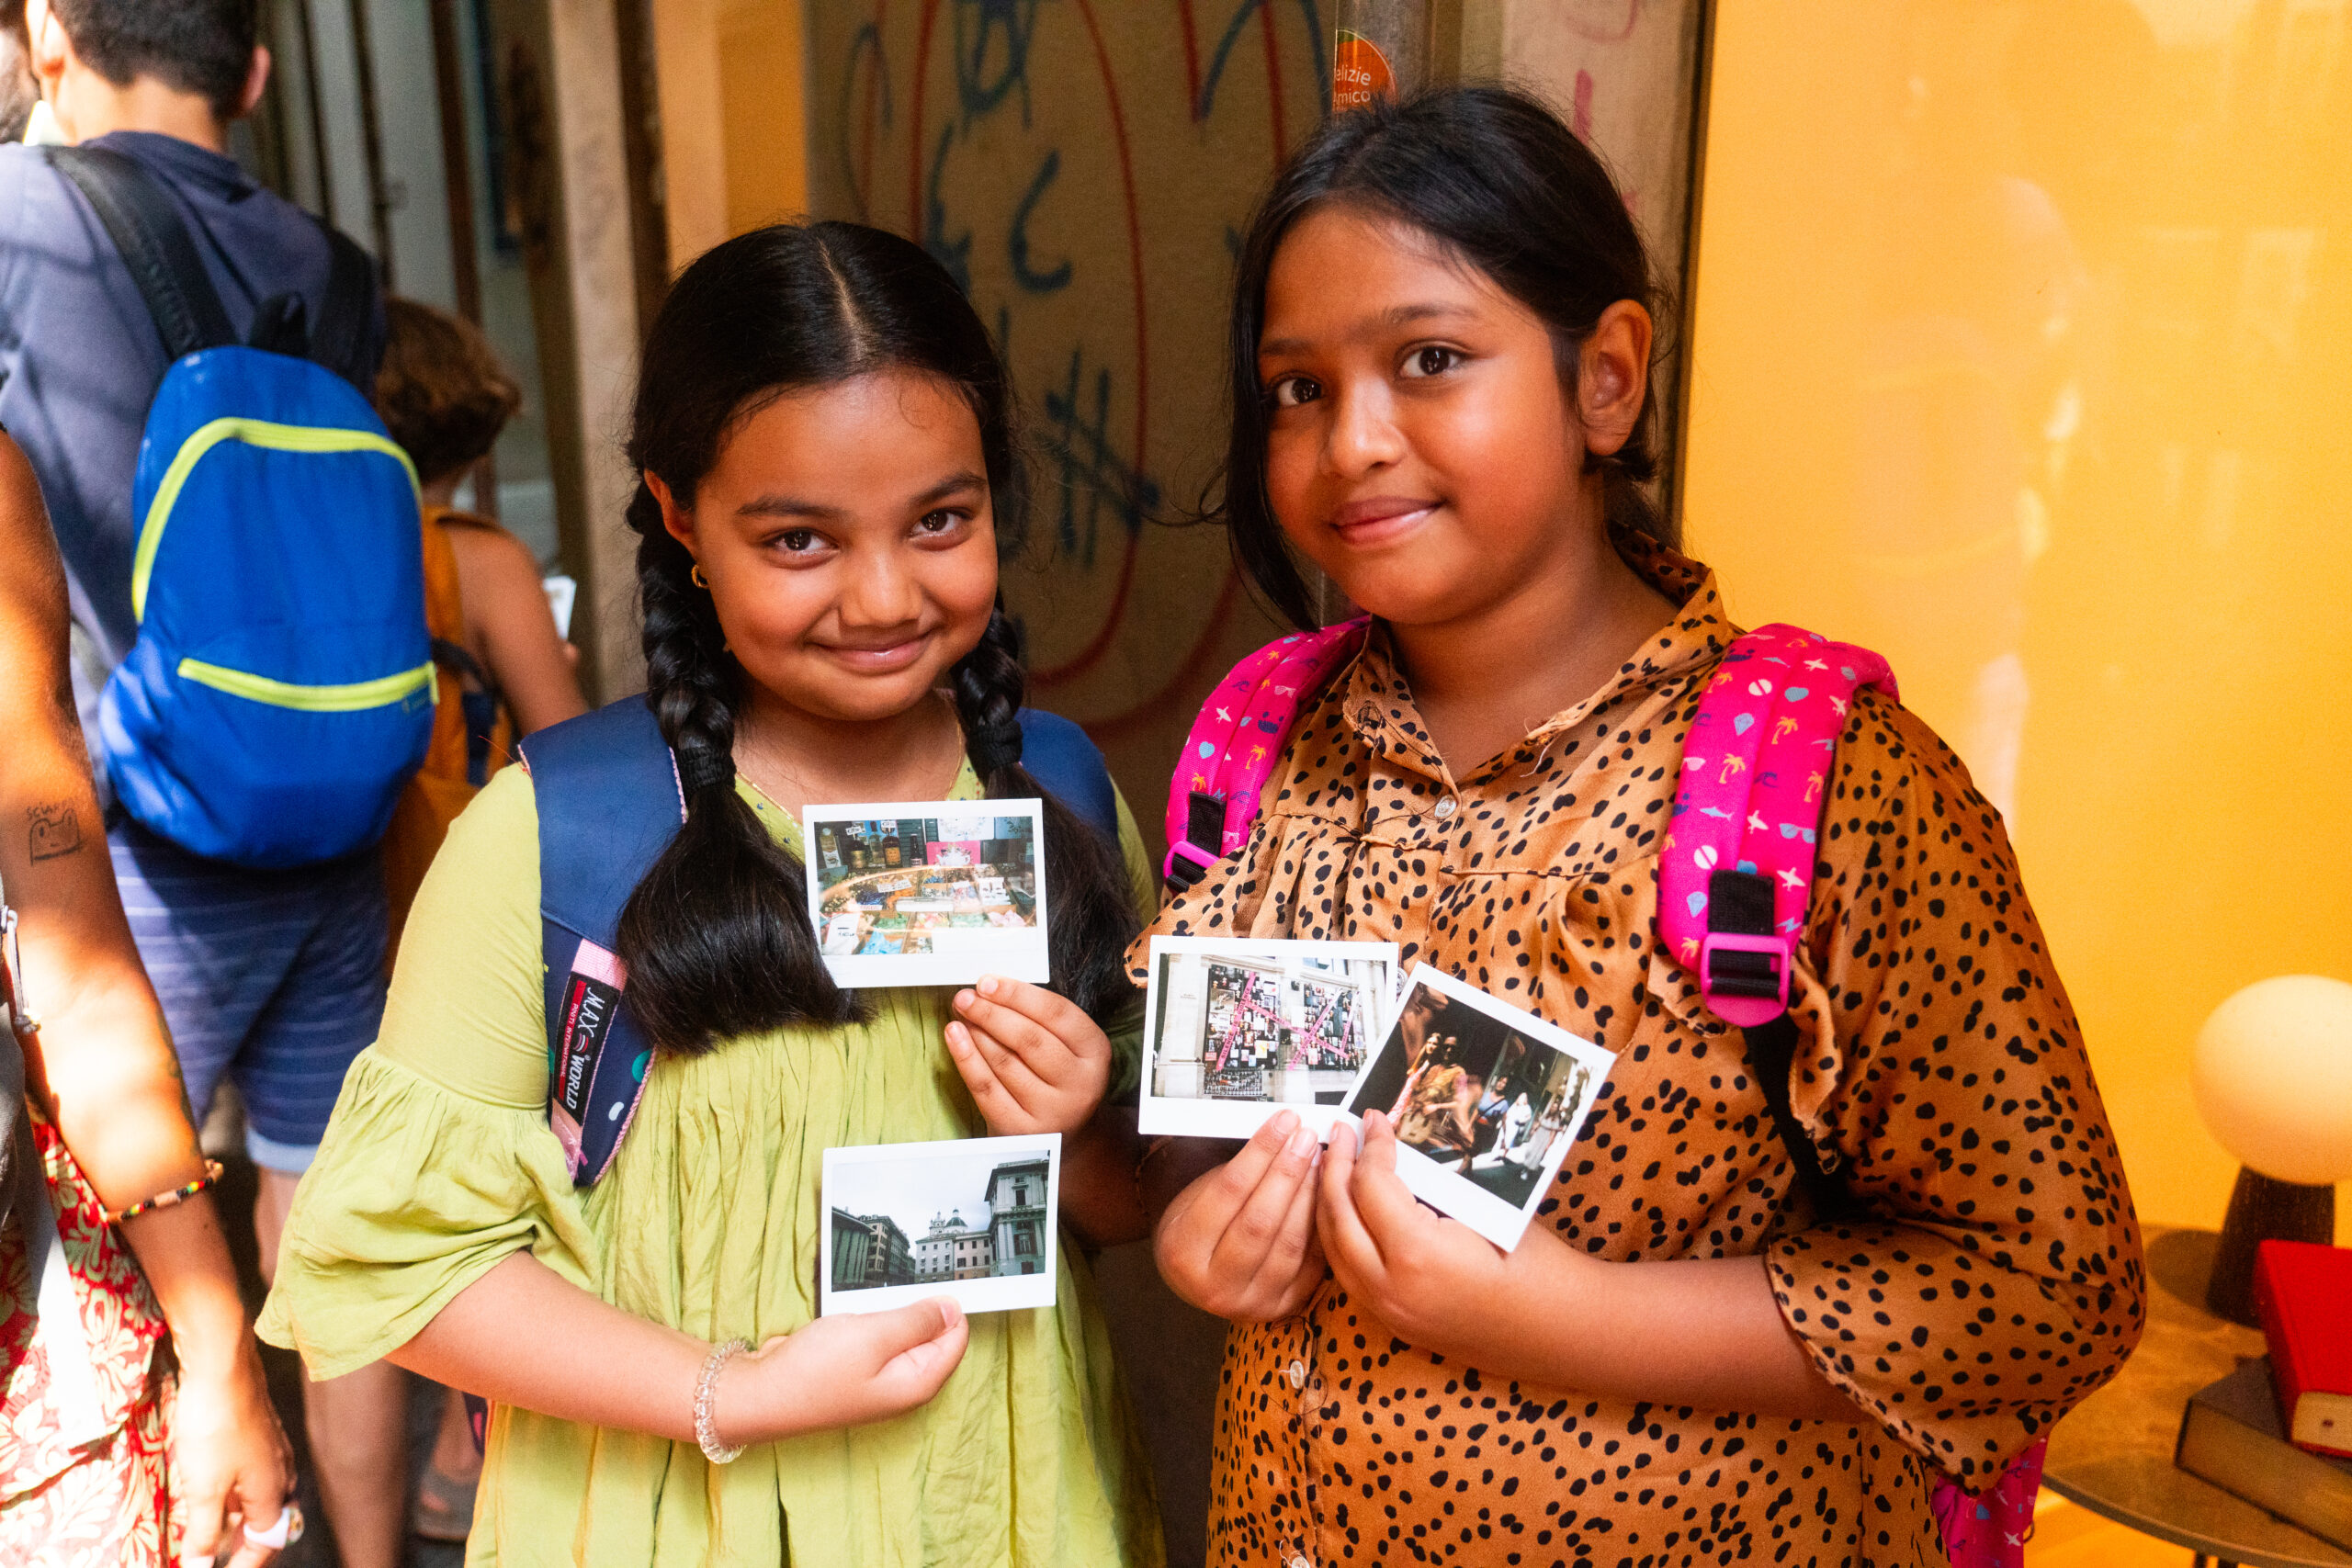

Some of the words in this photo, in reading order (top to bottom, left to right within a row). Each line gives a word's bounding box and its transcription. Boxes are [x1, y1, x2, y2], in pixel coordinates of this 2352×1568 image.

[1335, 65, 1372, 85] elizie
[578, 987, 605, 1038] MAX
[1220, 1032, 1235, 1059] SILENCE
[1237, 987, 1250, 1015] VIOLENCE
[560, 1024, 572, 1077] INTERNATIONAL
[566, 1054, 585, 1110] WORLD
